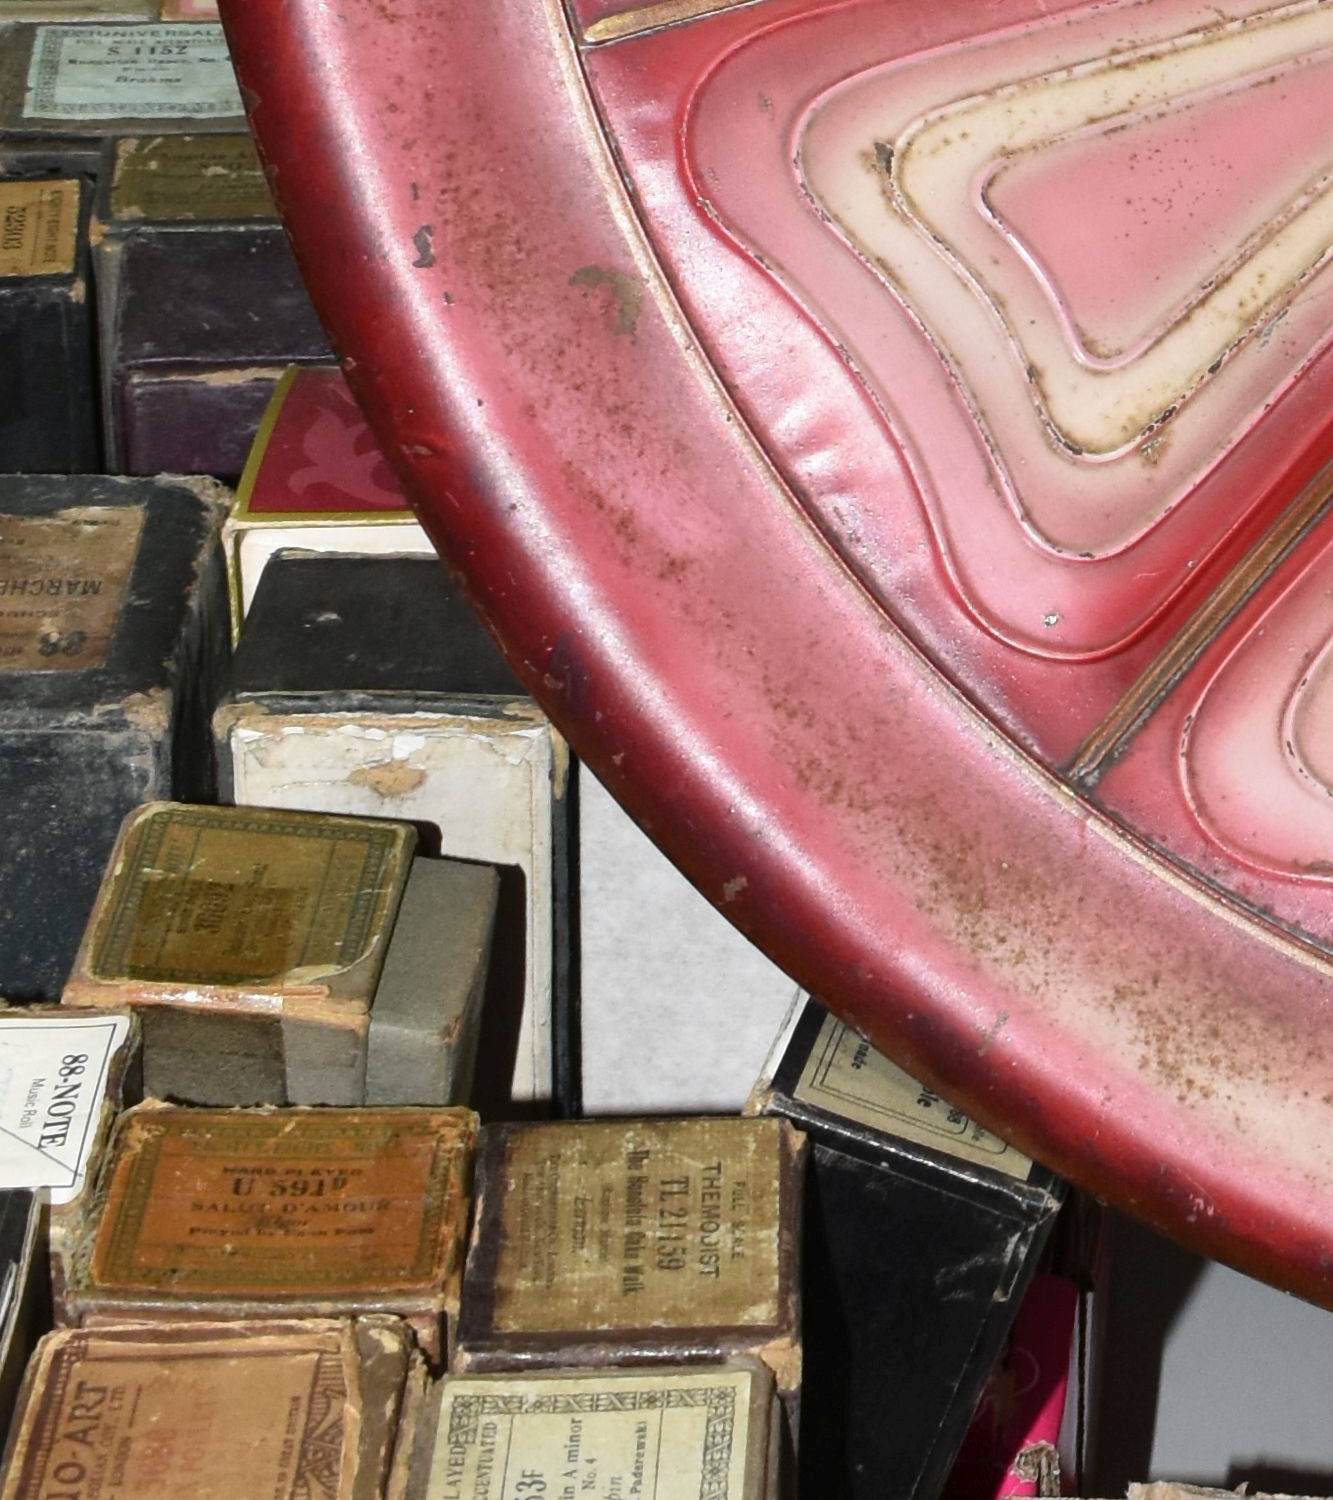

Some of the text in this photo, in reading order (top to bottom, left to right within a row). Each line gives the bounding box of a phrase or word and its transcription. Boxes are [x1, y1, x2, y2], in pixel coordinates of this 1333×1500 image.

[107, 46, 120, 56] S
[19, 1078, 46, 1129] Music Roll
[38, 1053, 89, 1150] 88-NOTE
[233, 1178, 256, 1196] U
[660, 1176, 689, 1203] TL
[699, 1161, 722, 1279] THEMODIST
[566, 1417, 583, 1464] minor
[630, 1420, 648, 1495] Paderewski
[557, 1484, 576, 1500] in
[563, 1467, 578, 1480] A
